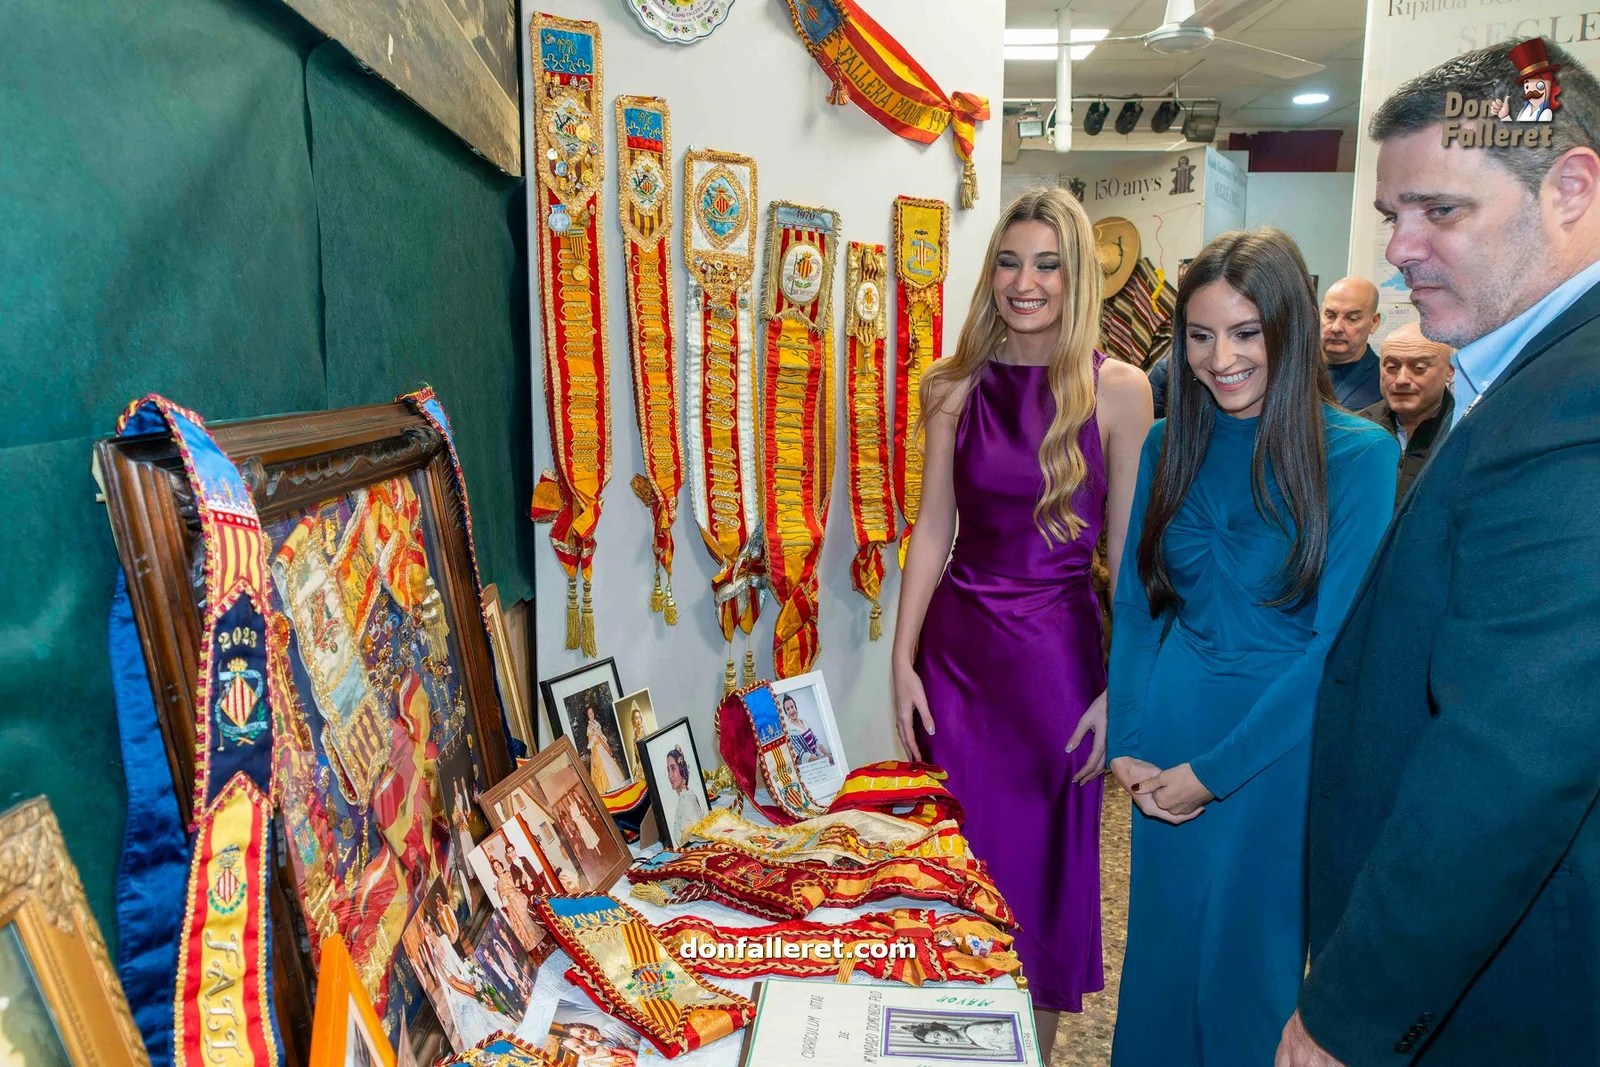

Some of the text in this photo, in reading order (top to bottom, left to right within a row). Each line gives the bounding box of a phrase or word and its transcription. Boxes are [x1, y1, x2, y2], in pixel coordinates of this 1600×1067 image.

[839, 44, 895, 109] FALLERA
[1095, 176, 1162, 200] 150 anys
[796, 209, 816, 221] 1970
[218, 626, 258, 652] 2023
[838, 1030, 850, 1041] DE
